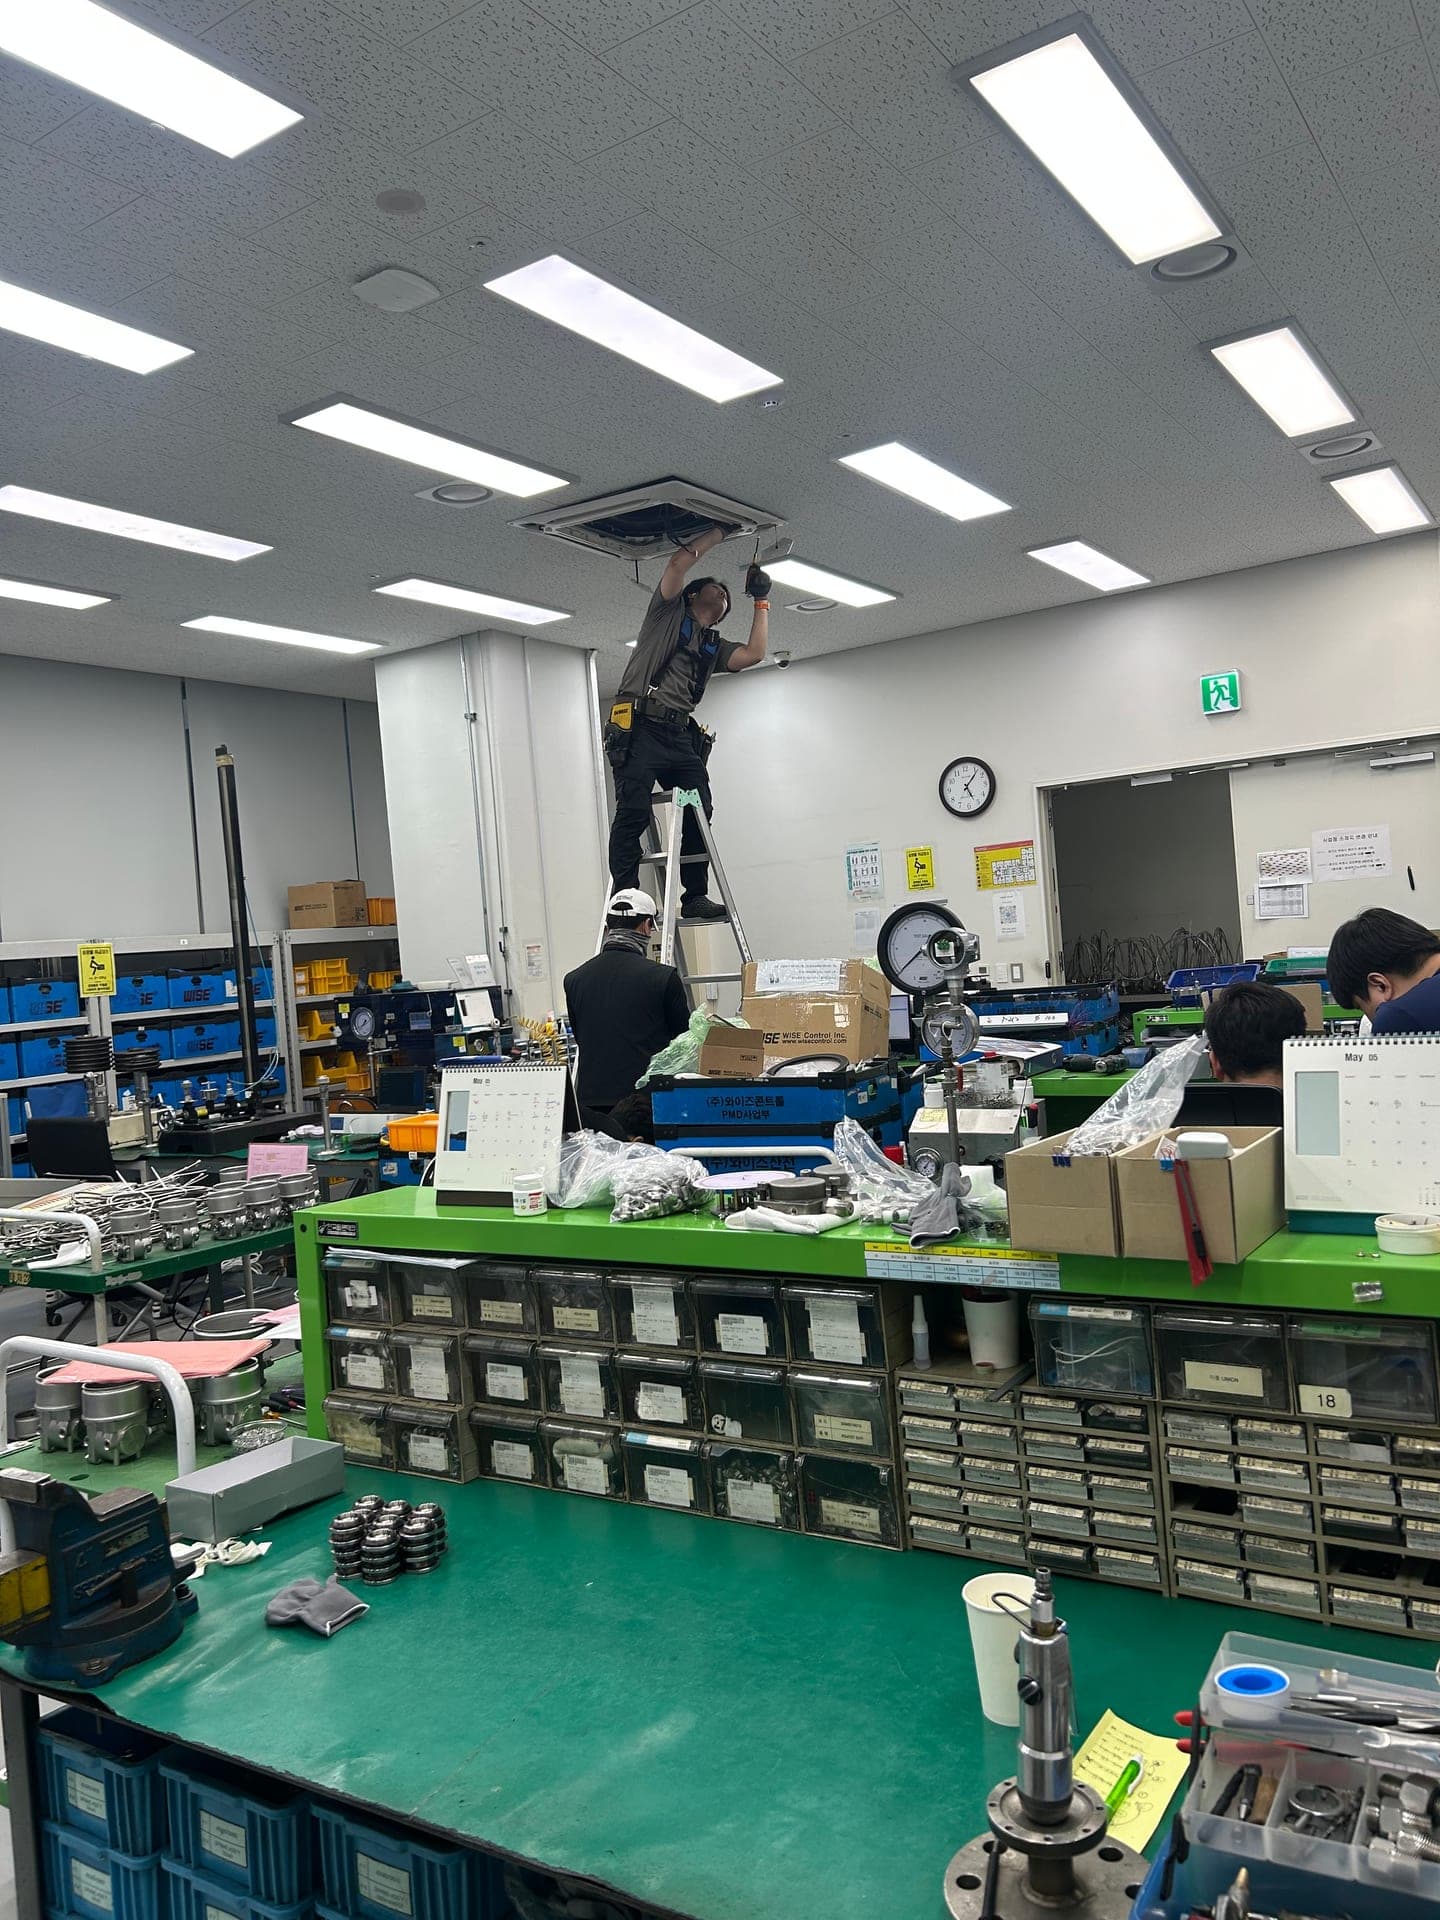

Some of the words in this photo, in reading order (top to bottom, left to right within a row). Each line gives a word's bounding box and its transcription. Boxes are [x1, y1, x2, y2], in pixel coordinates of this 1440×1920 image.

[183, 988, 211, 1003] WISE
[763, 1032, 781, 1045] ISE
[782, 1031, 801, 1039] WISE
[804, 1031, 831, 1039] Control
[833, 1031, 848, 1039] Inc.
[1345, 1053, 1363, 1063] May
[706, 1095, 785, 1108] (주)와이즈콘트롤
[722, 1109, 770, 1120] PMD사업부
[1316, 1393, 1337, 1408] 18
[714, 1415, 726, 1431] 27
